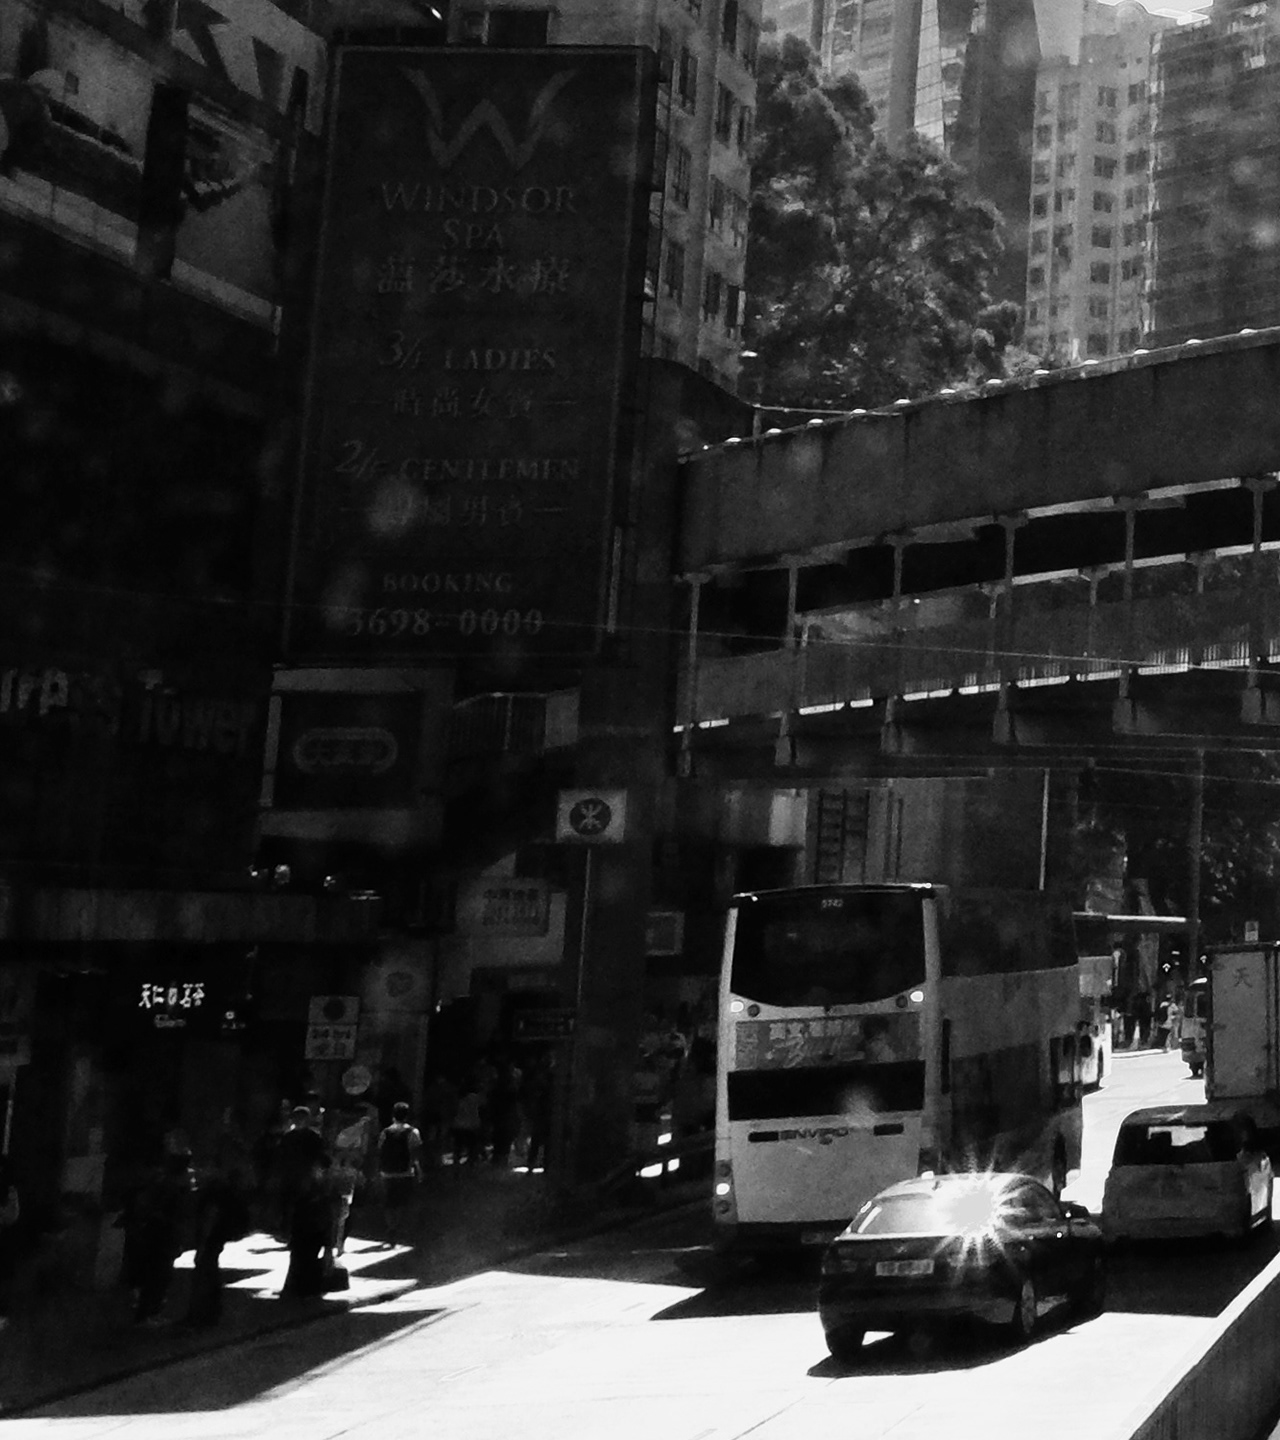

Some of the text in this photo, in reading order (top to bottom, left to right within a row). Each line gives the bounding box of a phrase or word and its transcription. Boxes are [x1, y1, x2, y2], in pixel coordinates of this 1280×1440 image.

[381, 181, 577, 214] WINDSOR
[442, 218, 503, 249] SPA
[445, 348, 557, 370] LADIES
[399, 458, 580, 481] GENTLEMEN
[382, 571, 513, 594] BOOKING
